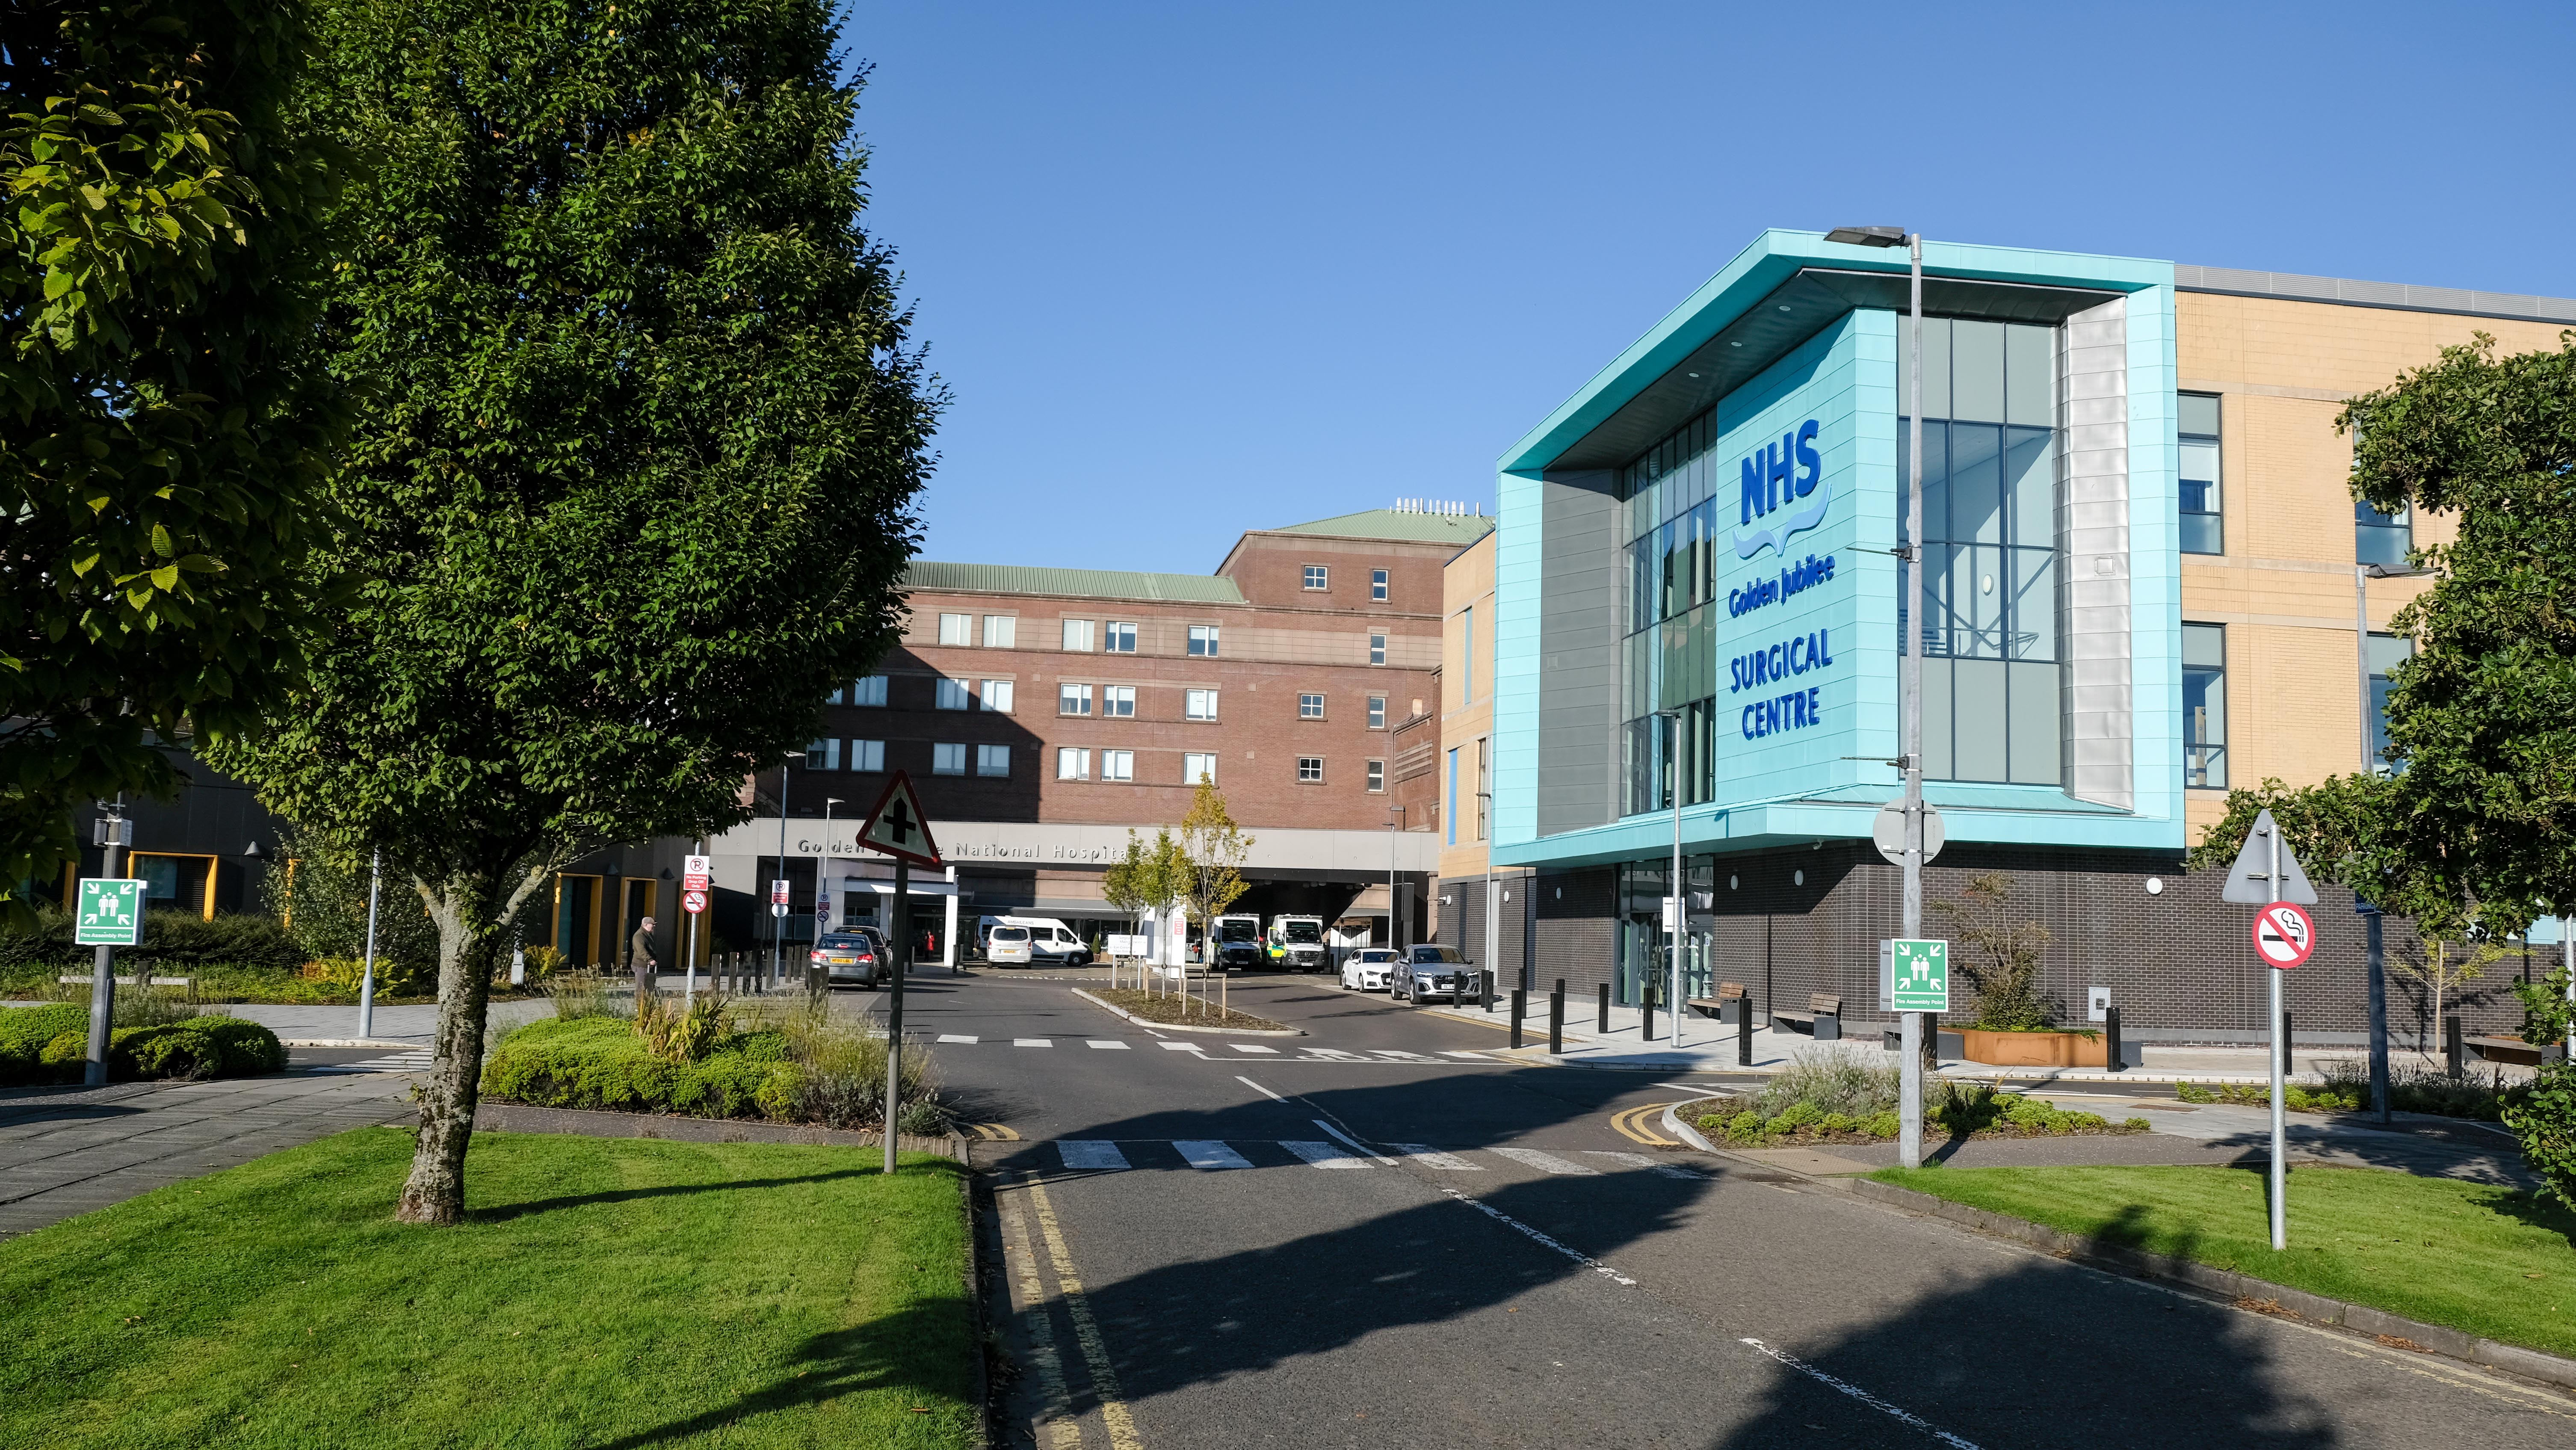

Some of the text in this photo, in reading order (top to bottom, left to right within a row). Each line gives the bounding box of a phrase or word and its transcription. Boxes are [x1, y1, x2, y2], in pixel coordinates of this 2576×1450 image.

[1742, 419, 1821, 527] NHS
[1729, 554, 1835, 618] Golden Jubilee
[1731, 628, 1833, 693] SURGICAL
[1742, 687, 1820, 740] CENTRE
[956, 843, 1039, 858] National
[1053, 845, 1127, 863] Hospita
